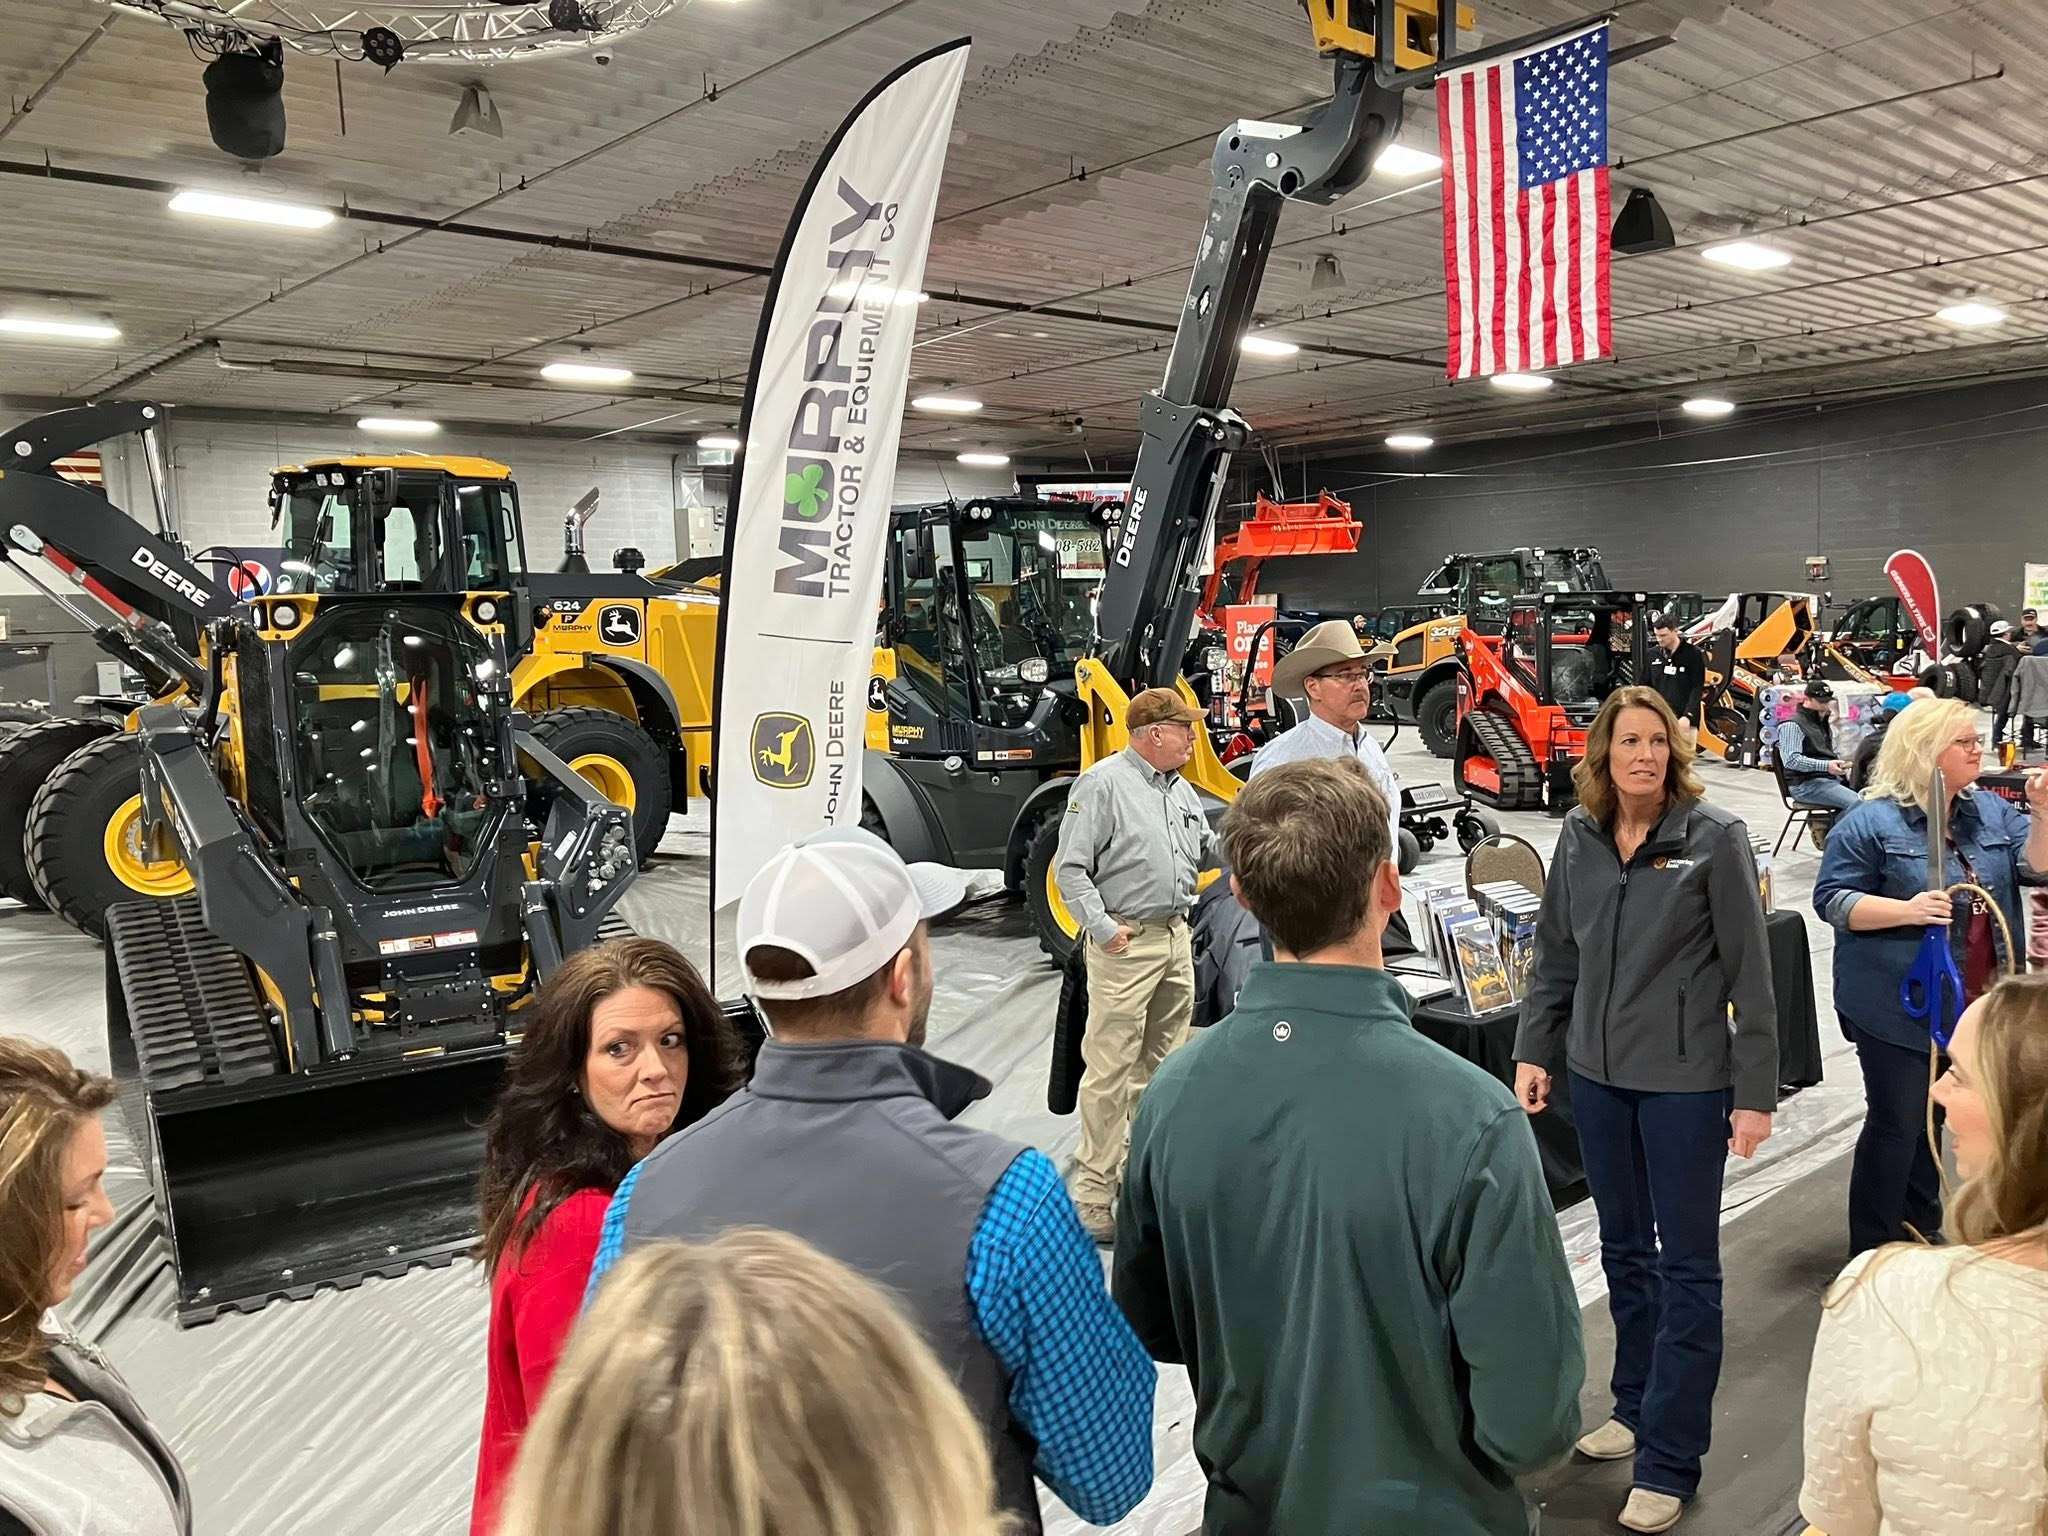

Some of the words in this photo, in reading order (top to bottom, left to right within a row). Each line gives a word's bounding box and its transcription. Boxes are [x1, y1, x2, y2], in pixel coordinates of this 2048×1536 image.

[848, 253, 890, 424] EQUIPMENT
[774, 176, 883, 597] MURPHY
[844, 436, 865, 453] &
[829, 465, 862, 598] TRACTOR
[1010, 518, 1045, 530] JOHN
[1116, 486, 1148, 568] DEERE
[130, 546, 211, 608] DEERE
[553, 601, 581, 611] 624
[564, 615, 573, 623] P
[826, 680, 844, 758] DEERE
[824, 763, 844, 826] JOHN
[382, 908, 417, 918] JOHN
[417, 903, 460, 914] DEERE
